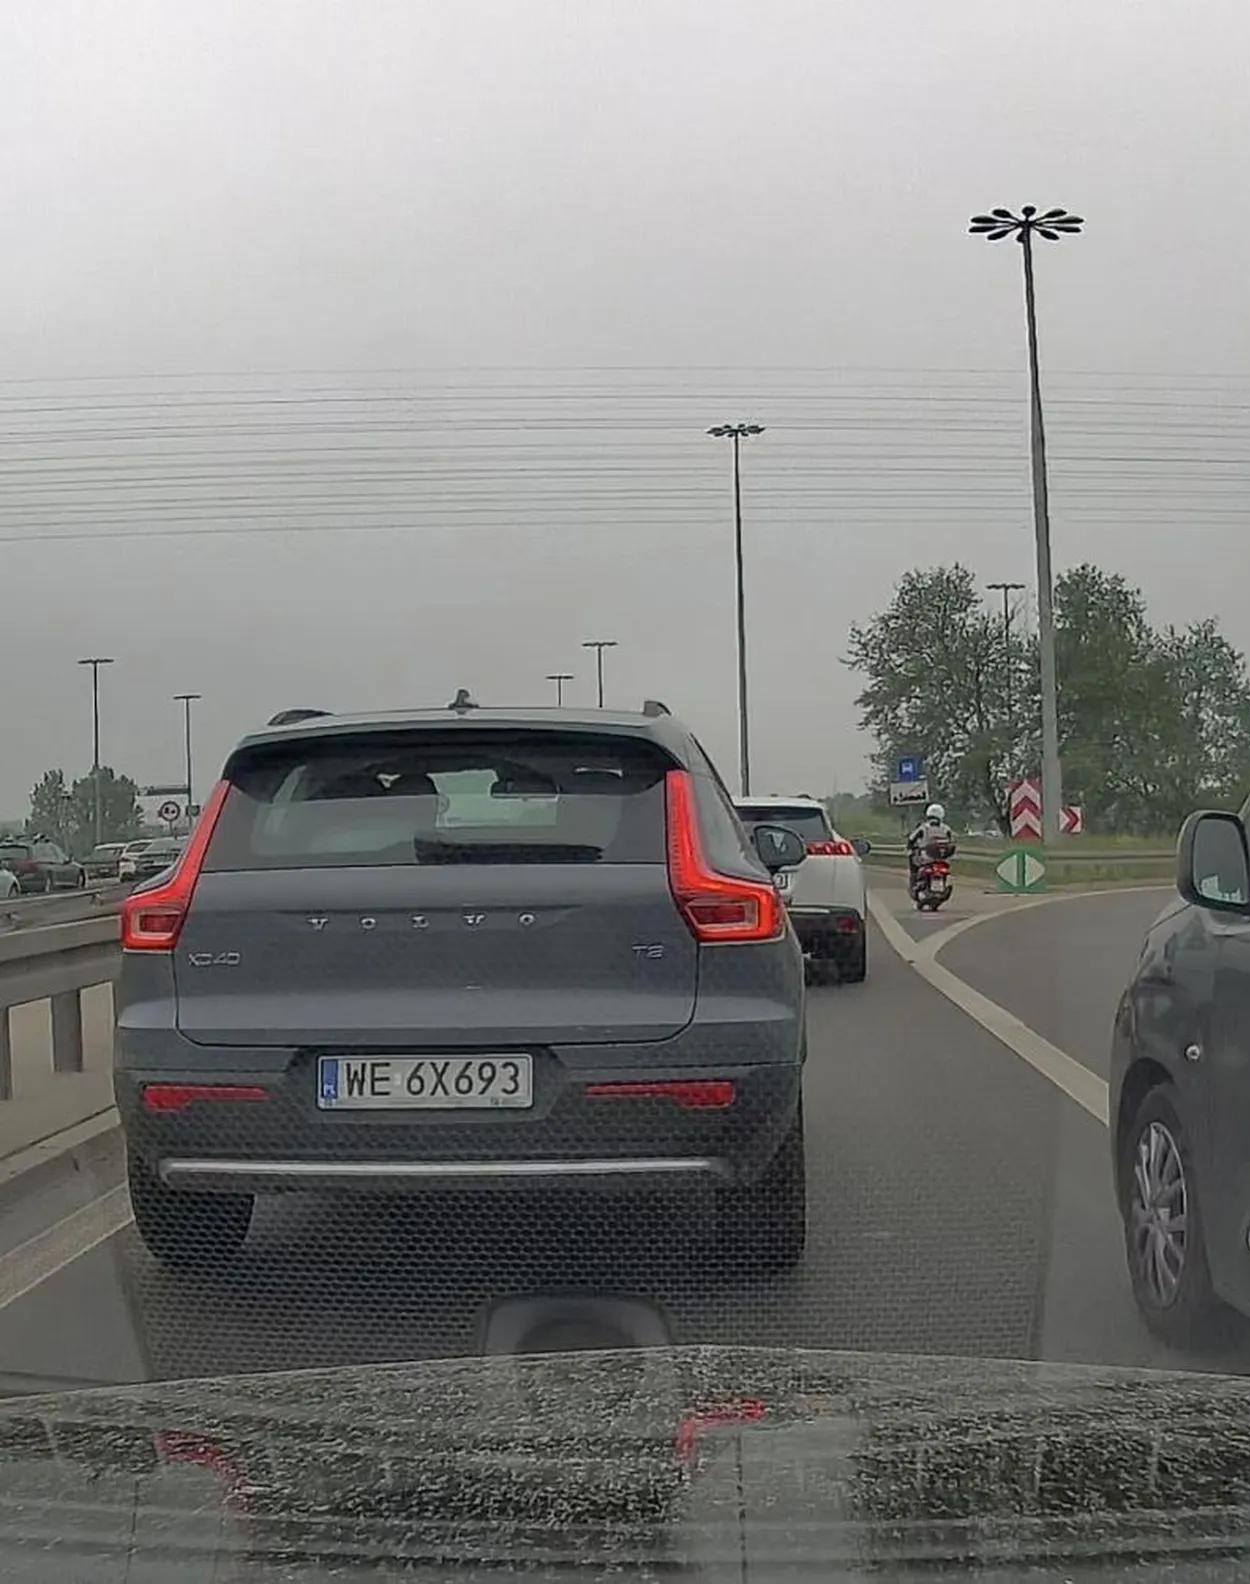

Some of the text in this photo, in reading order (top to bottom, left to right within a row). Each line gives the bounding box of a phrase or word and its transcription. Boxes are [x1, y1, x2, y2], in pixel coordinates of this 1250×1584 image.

[307, 911, 536, 932] VOLVO
[188, 952, 241, 966] XC40
[345, 1061, 520, 1097] WE 6X693
